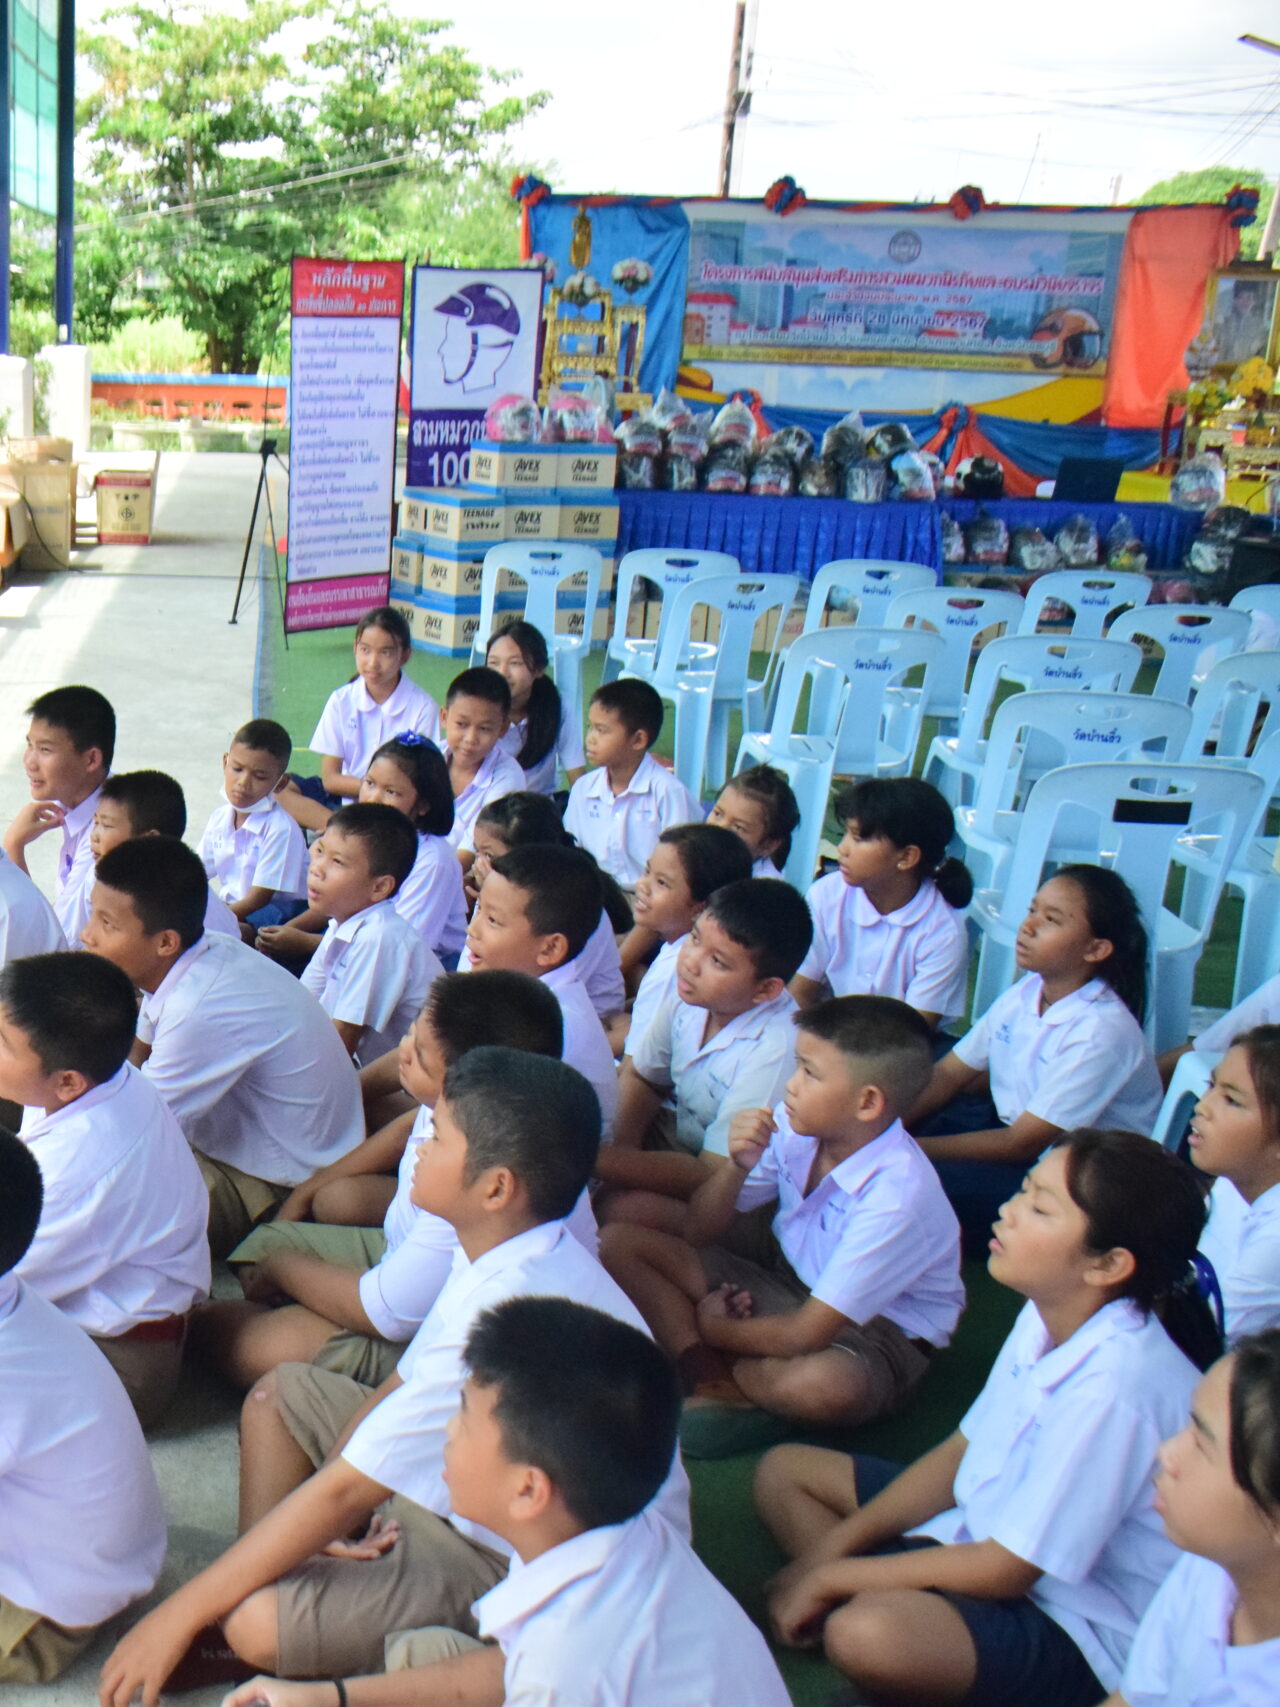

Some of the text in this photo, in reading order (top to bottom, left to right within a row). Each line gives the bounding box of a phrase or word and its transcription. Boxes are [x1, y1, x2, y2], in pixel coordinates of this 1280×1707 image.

[948, 315, 986, 330] 2567
[514, 458, 541, 473] AVEX
[572, 459, 599, 473] AVEX
[463, 508, 496, 518] TEENAGE
[514, 510, 542, 525] AVEX
[574, 511, 601, 525] AVEX
